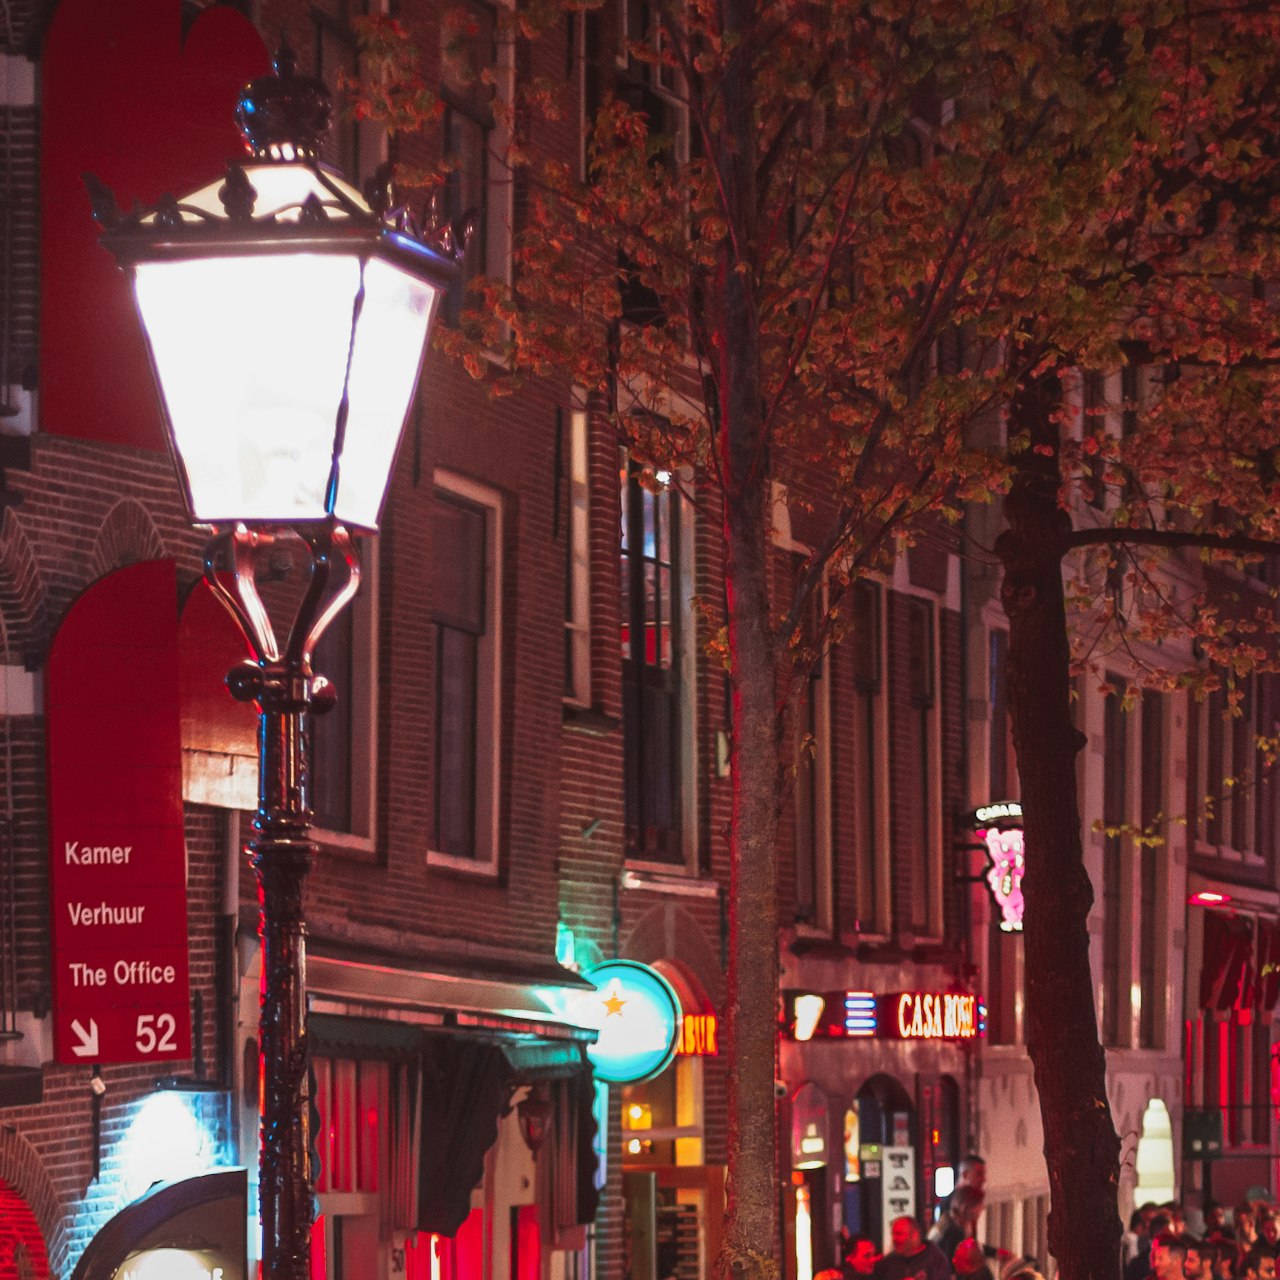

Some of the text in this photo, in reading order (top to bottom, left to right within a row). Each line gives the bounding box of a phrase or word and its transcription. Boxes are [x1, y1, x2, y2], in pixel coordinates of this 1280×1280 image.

[65, 841, 132, 865] Kamer
[68, 902, 145, 926] Verhuur
[69, 960, 176, 987] The Office
[898, 993, 943, 1038] CASA
[135, 1013, 177, 1053] 52
